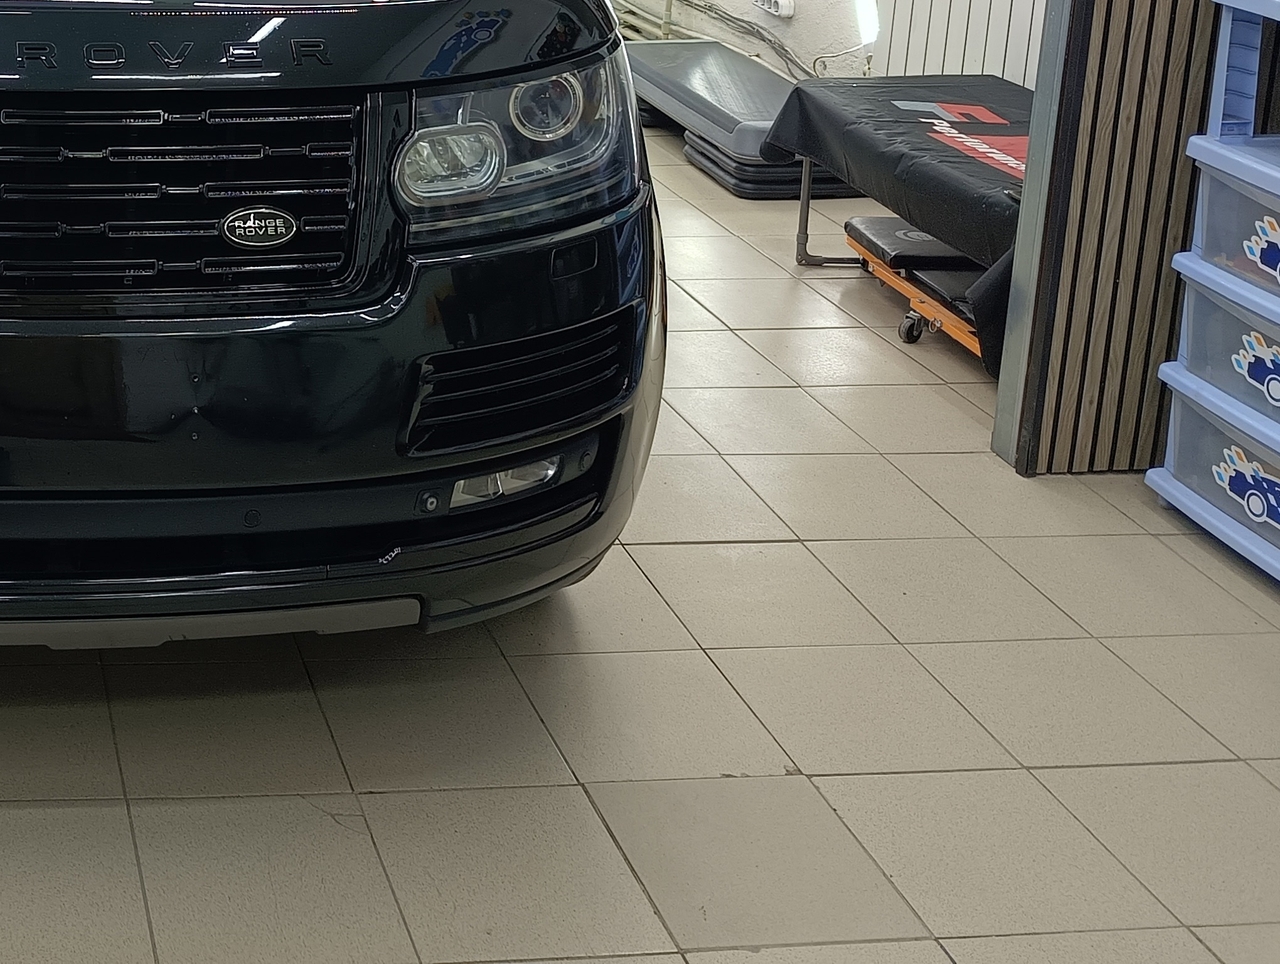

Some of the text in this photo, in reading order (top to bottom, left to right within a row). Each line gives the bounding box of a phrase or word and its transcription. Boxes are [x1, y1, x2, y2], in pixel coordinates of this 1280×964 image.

[15, 38, 333, 68] ROVER
[234, 219, 285, 228] RANGE
[235, 227, 286, 236] ROVER
